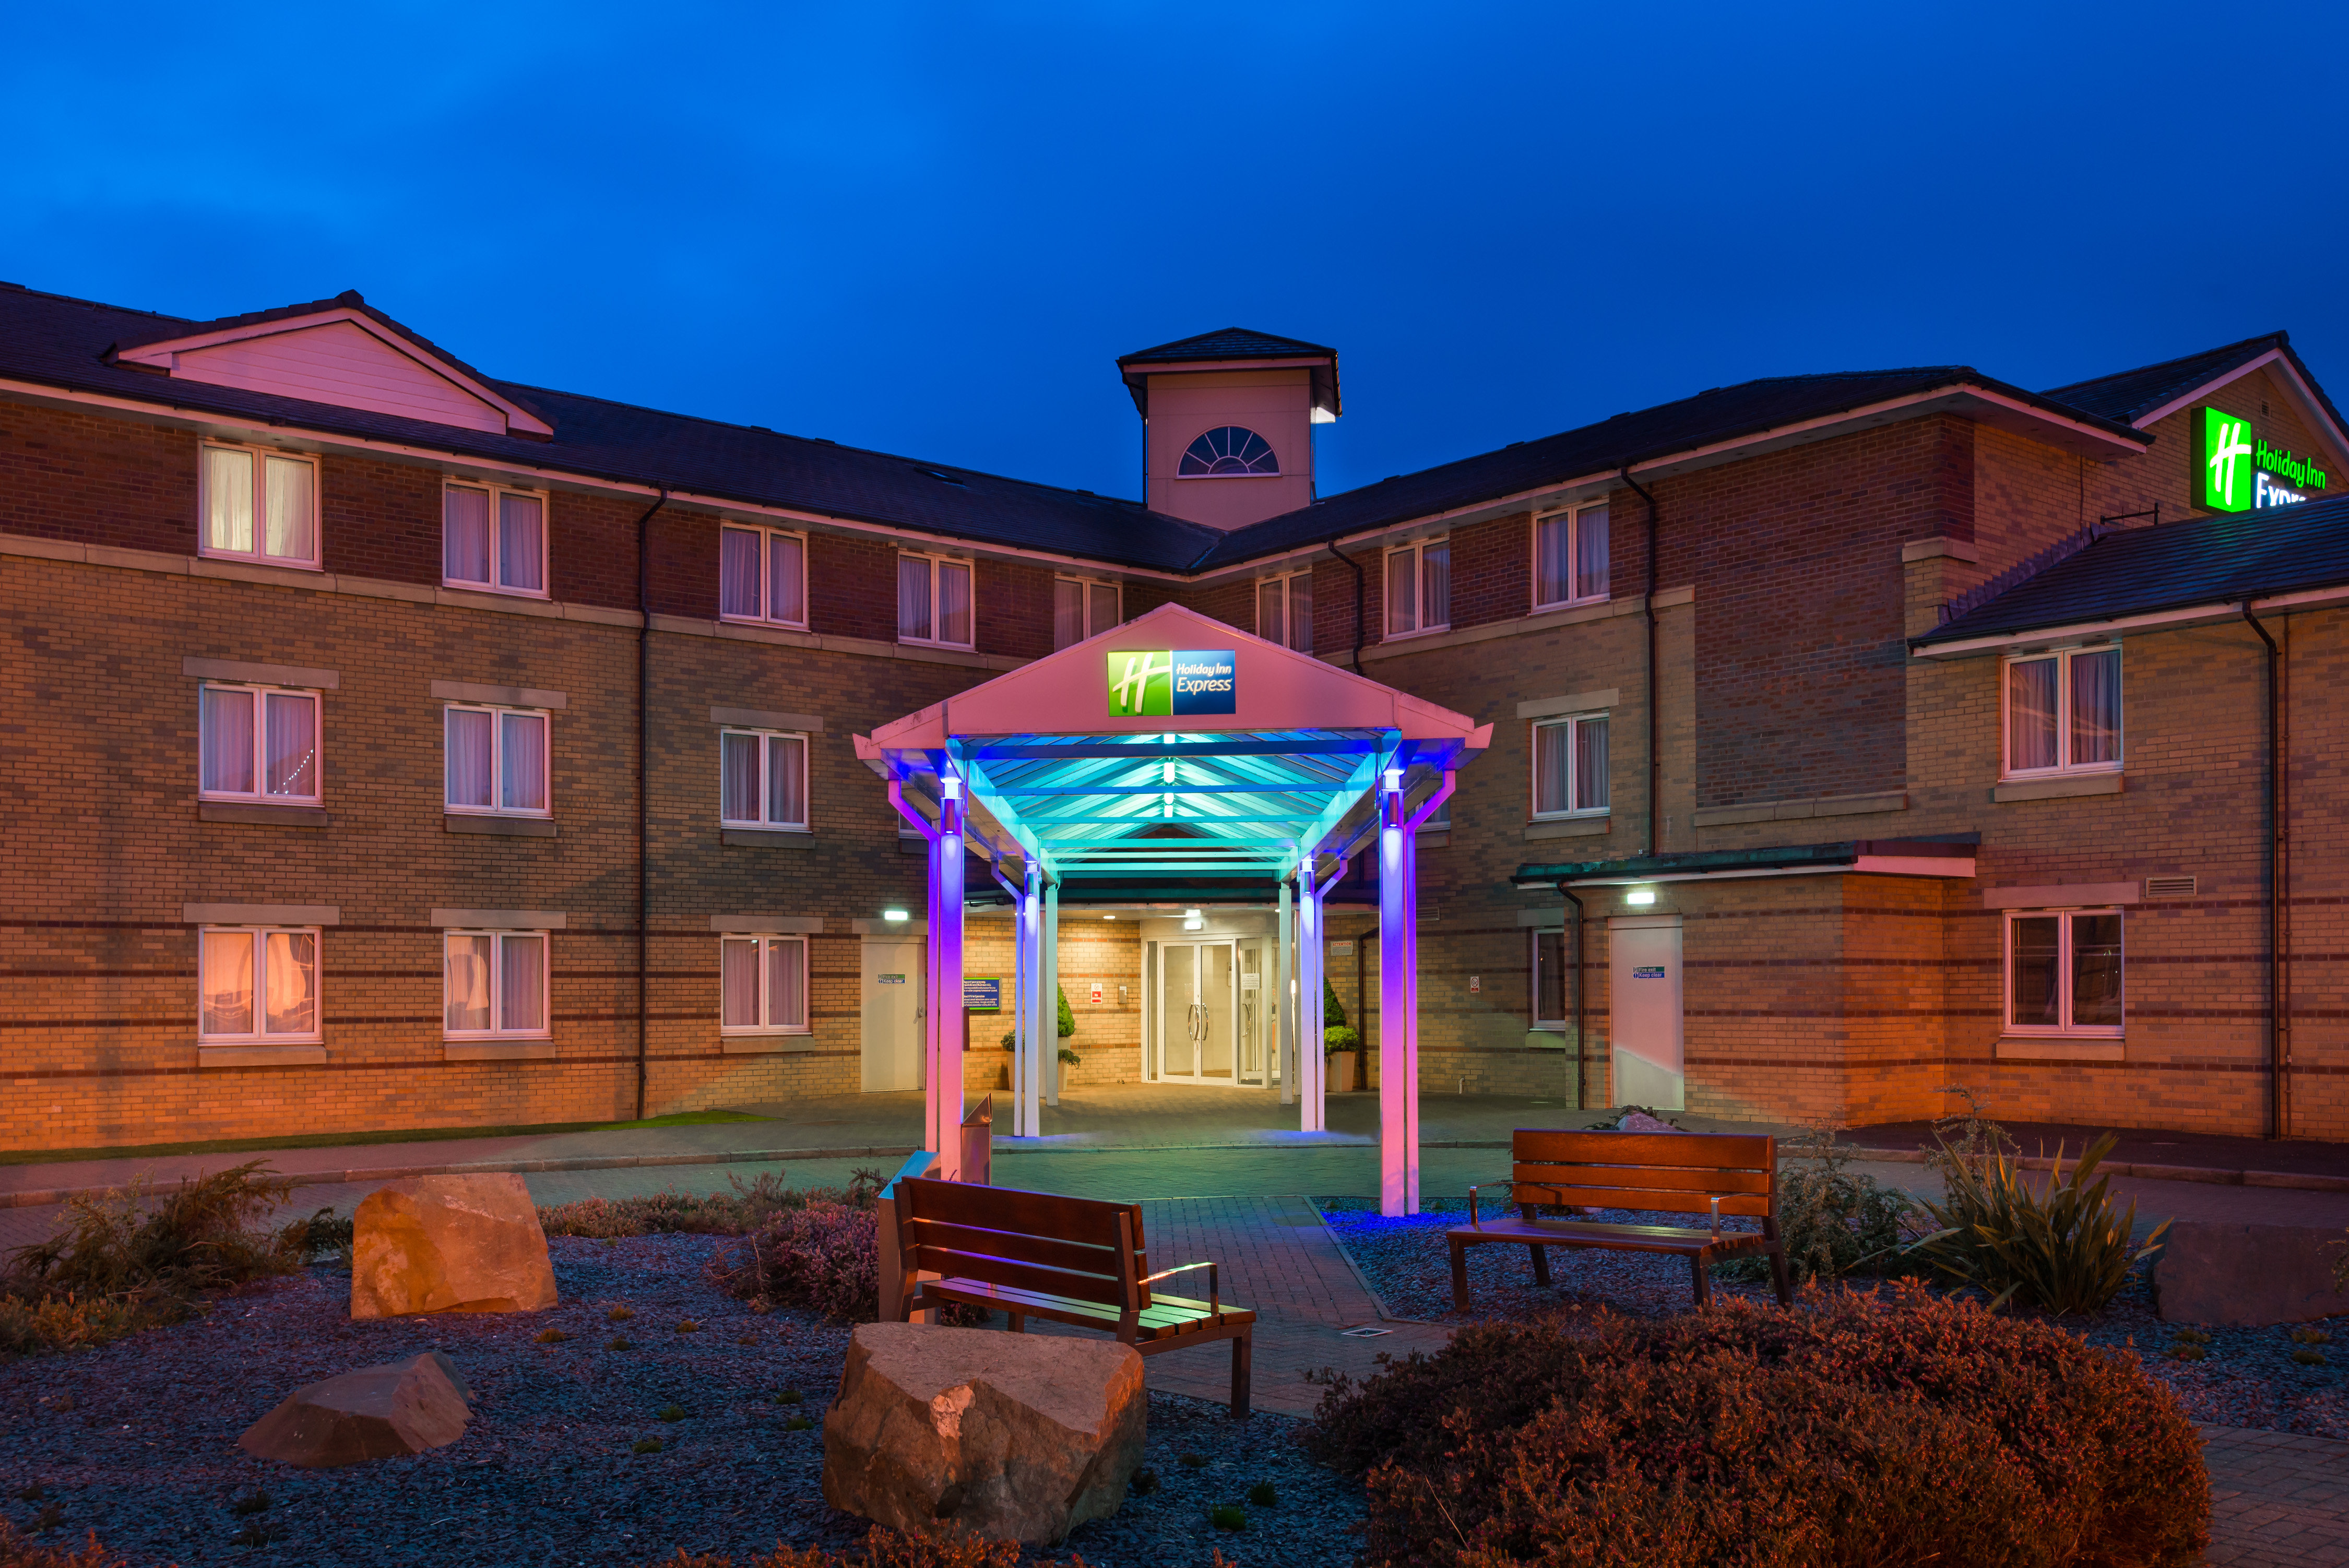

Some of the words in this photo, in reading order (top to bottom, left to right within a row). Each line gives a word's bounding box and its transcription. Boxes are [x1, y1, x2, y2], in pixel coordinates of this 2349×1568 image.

[2256, 439, 2305, 488] Holiday
[2306, 457, 2326, 489] Inn
[1176, 663, 1215, 676] Holiday
[1215, 662, 1232, 674] Inn
[1177, 677, 1232, 695] Express
